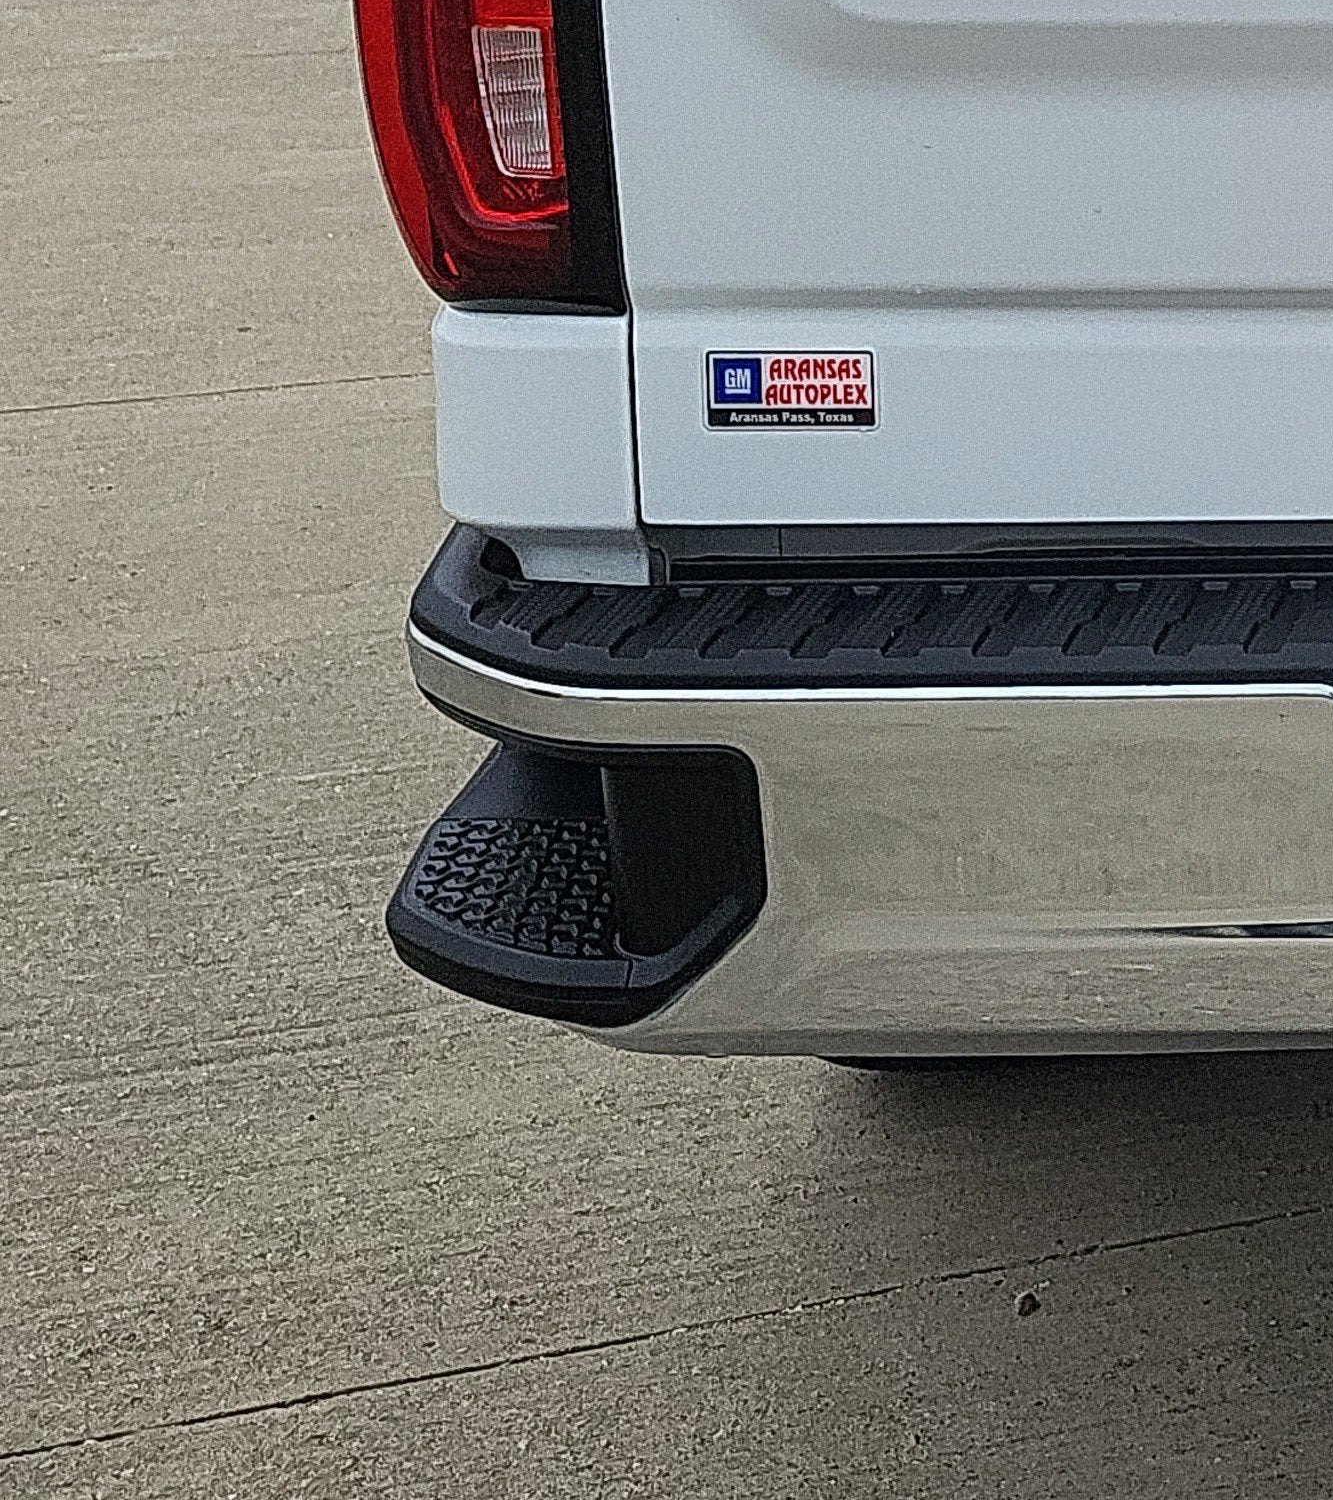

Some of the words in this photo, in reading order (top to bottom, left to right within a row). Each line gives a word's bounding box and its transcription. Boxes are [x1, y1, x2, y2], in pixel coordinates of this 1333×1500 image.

[724, 368, 751, 390] GM
[769, 358, 862, 382] ARANSAS
[765, 383, 867, 406] AUTOPLEX
[729, 412, 779, 423] Aransas
[782, 412, 815, 424] Pass,
[817, 412, 854, 423] Texas
